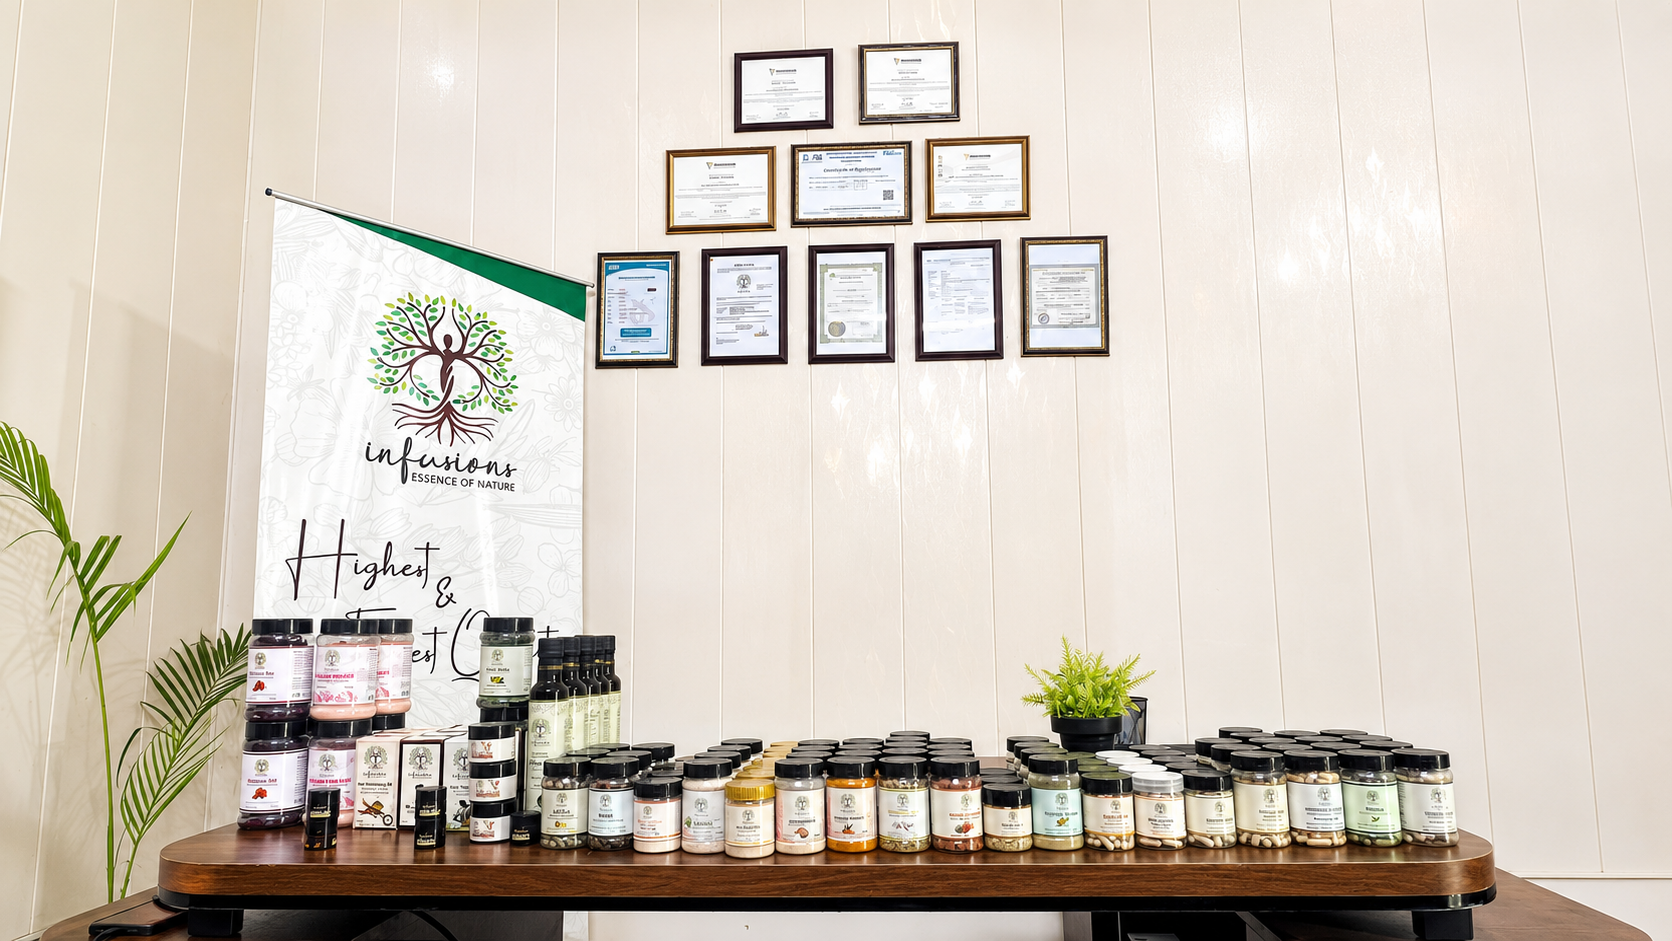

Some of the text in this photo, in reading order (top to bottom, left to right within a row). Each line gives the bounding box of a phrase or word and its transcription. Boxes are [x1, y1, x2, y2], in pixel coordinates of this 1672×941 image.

[365, 436, 518, 485] infusions
[411, 472, 516, 492] ESSENCE OF NATURE
[285, 518, 441, 601] Highest
[435, 576, 457, 608] &
